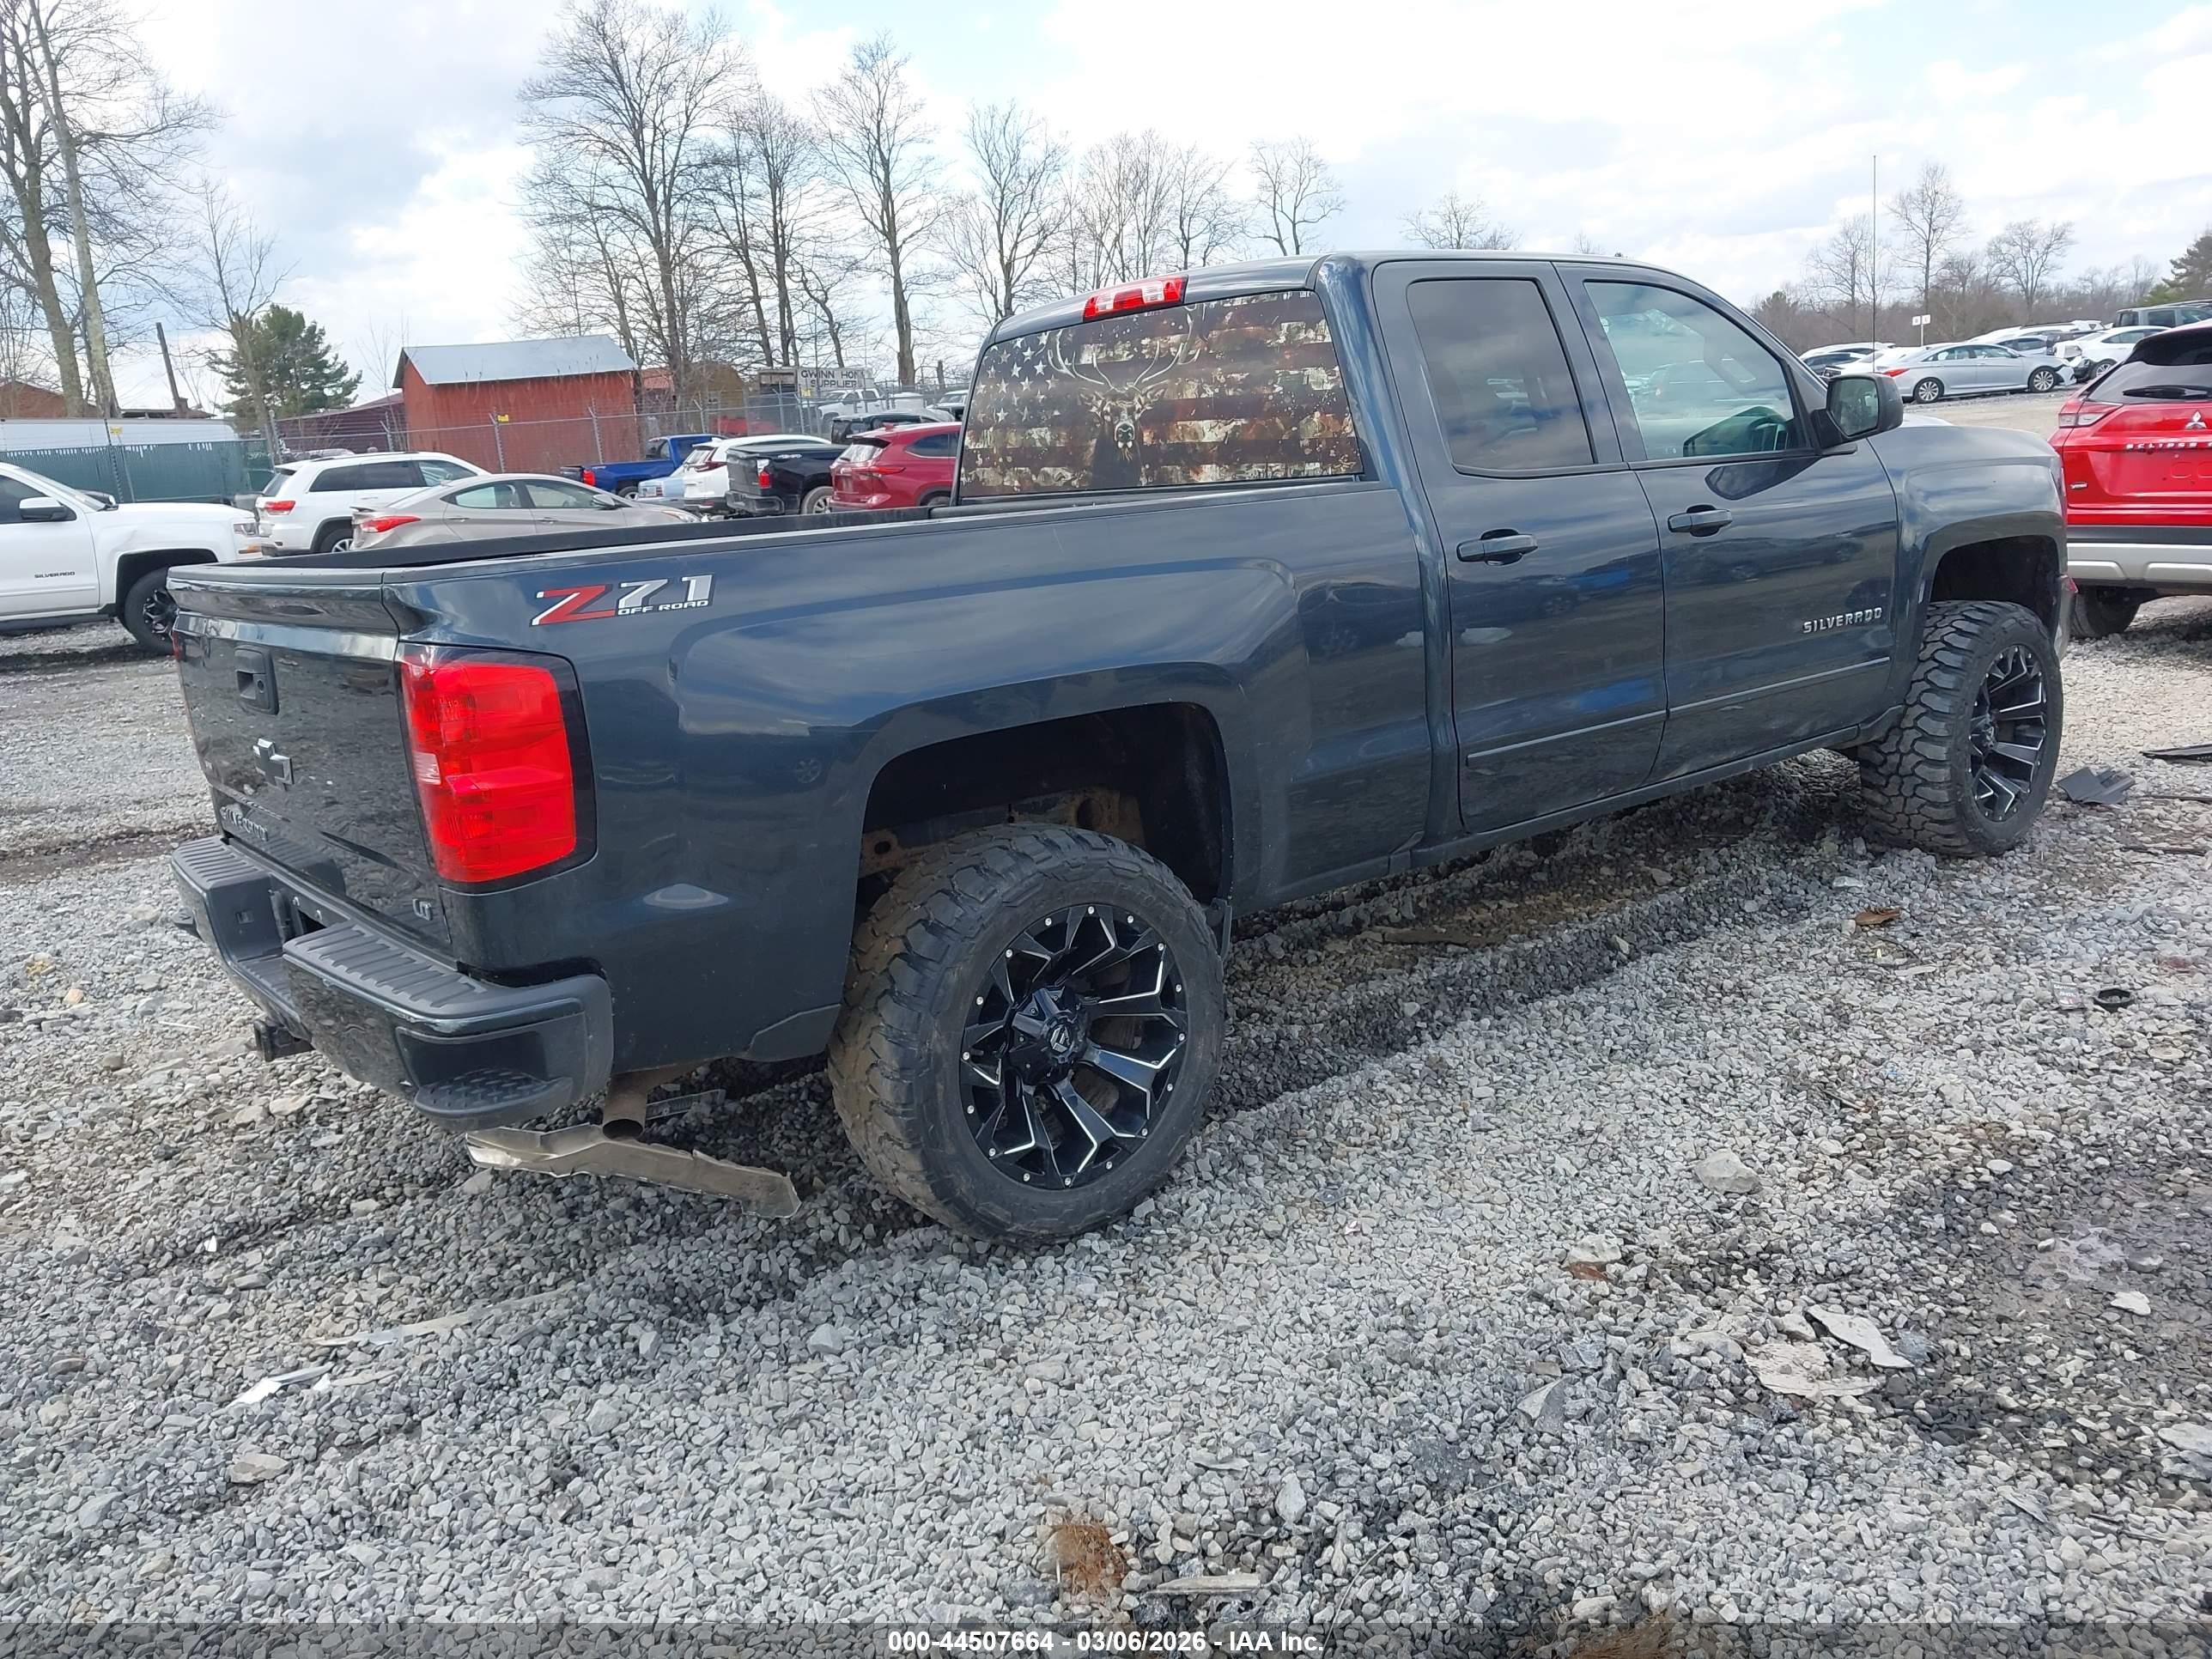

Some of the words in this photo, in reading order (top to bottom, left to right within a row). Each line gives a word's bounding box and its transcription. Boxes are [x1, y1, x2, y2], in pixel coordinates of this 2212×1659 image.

[800, 369, 835, 379] GWINN
[531, 574, 713, 626] Z71
[617, 605, 653, 616] OFF
[659, 599, 709, 611] ROAD
[1803, 607, 1882, 634] SILVERADO
